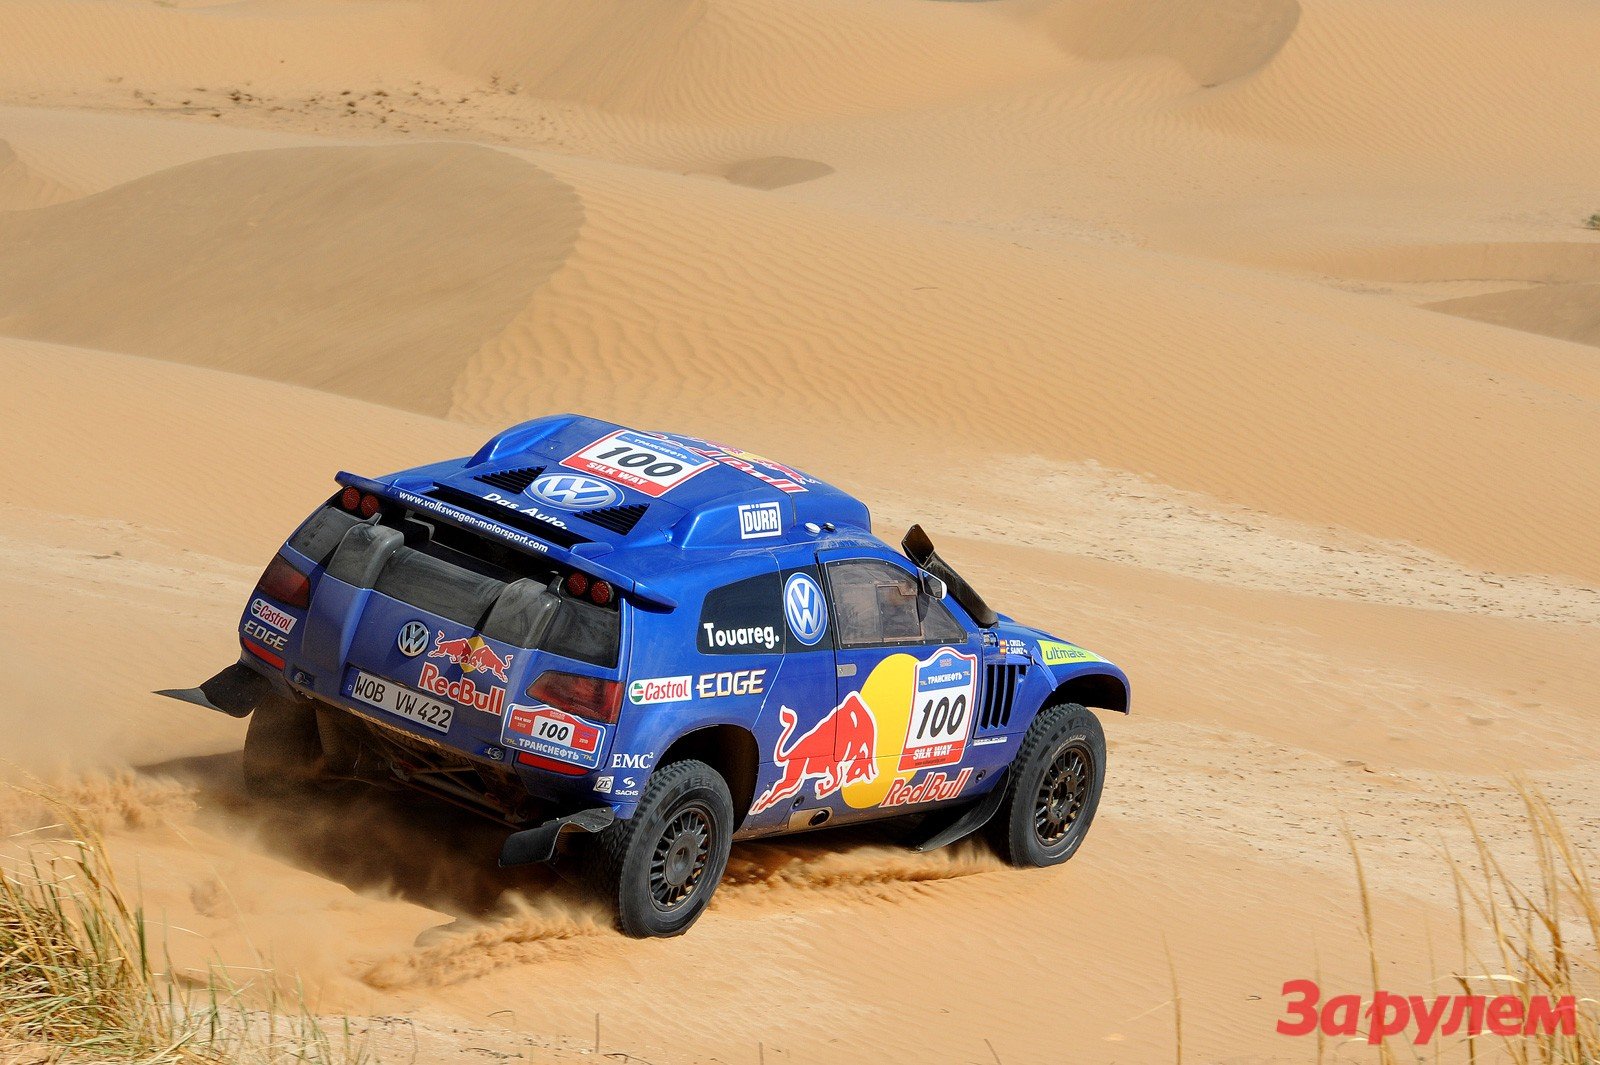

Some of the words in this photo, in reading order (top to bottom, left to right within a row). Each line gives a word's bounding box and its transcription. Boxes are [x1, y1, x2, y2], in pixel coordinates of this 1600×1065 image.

[586, 462, 616, 475] SILK
[616, 472, 649, 485] WAY
[597, 447, 683, 477] 100
[399, 491, 549, 553] www.volkswagen-motorsport.com
[482, 492, 519, 510] Das
[519, 507, 568, 530] Auto.
[259, 605, 292, 631] Castrol
[244, 620, 288, 651] EDGE
[703, 623, 780, 649] Touareg.
[1046, 647, 1086, 660] ultimate
[644, 680, 688, 700] Castrol
[696, 669, 767, 698] EDGE
[354, 675, 386, 703] WOB
[396, 691, 418, 715] VW
[418, 702, 452, 729] 422
[916, 694, 967, 740] 100
[538, 721, 569, 742] 100
[519, 738, 580, 760] ТРАНСНЕФТЬ
[913, 747, 932, 760] SILK
[933, 744, 953, 757] WAY
